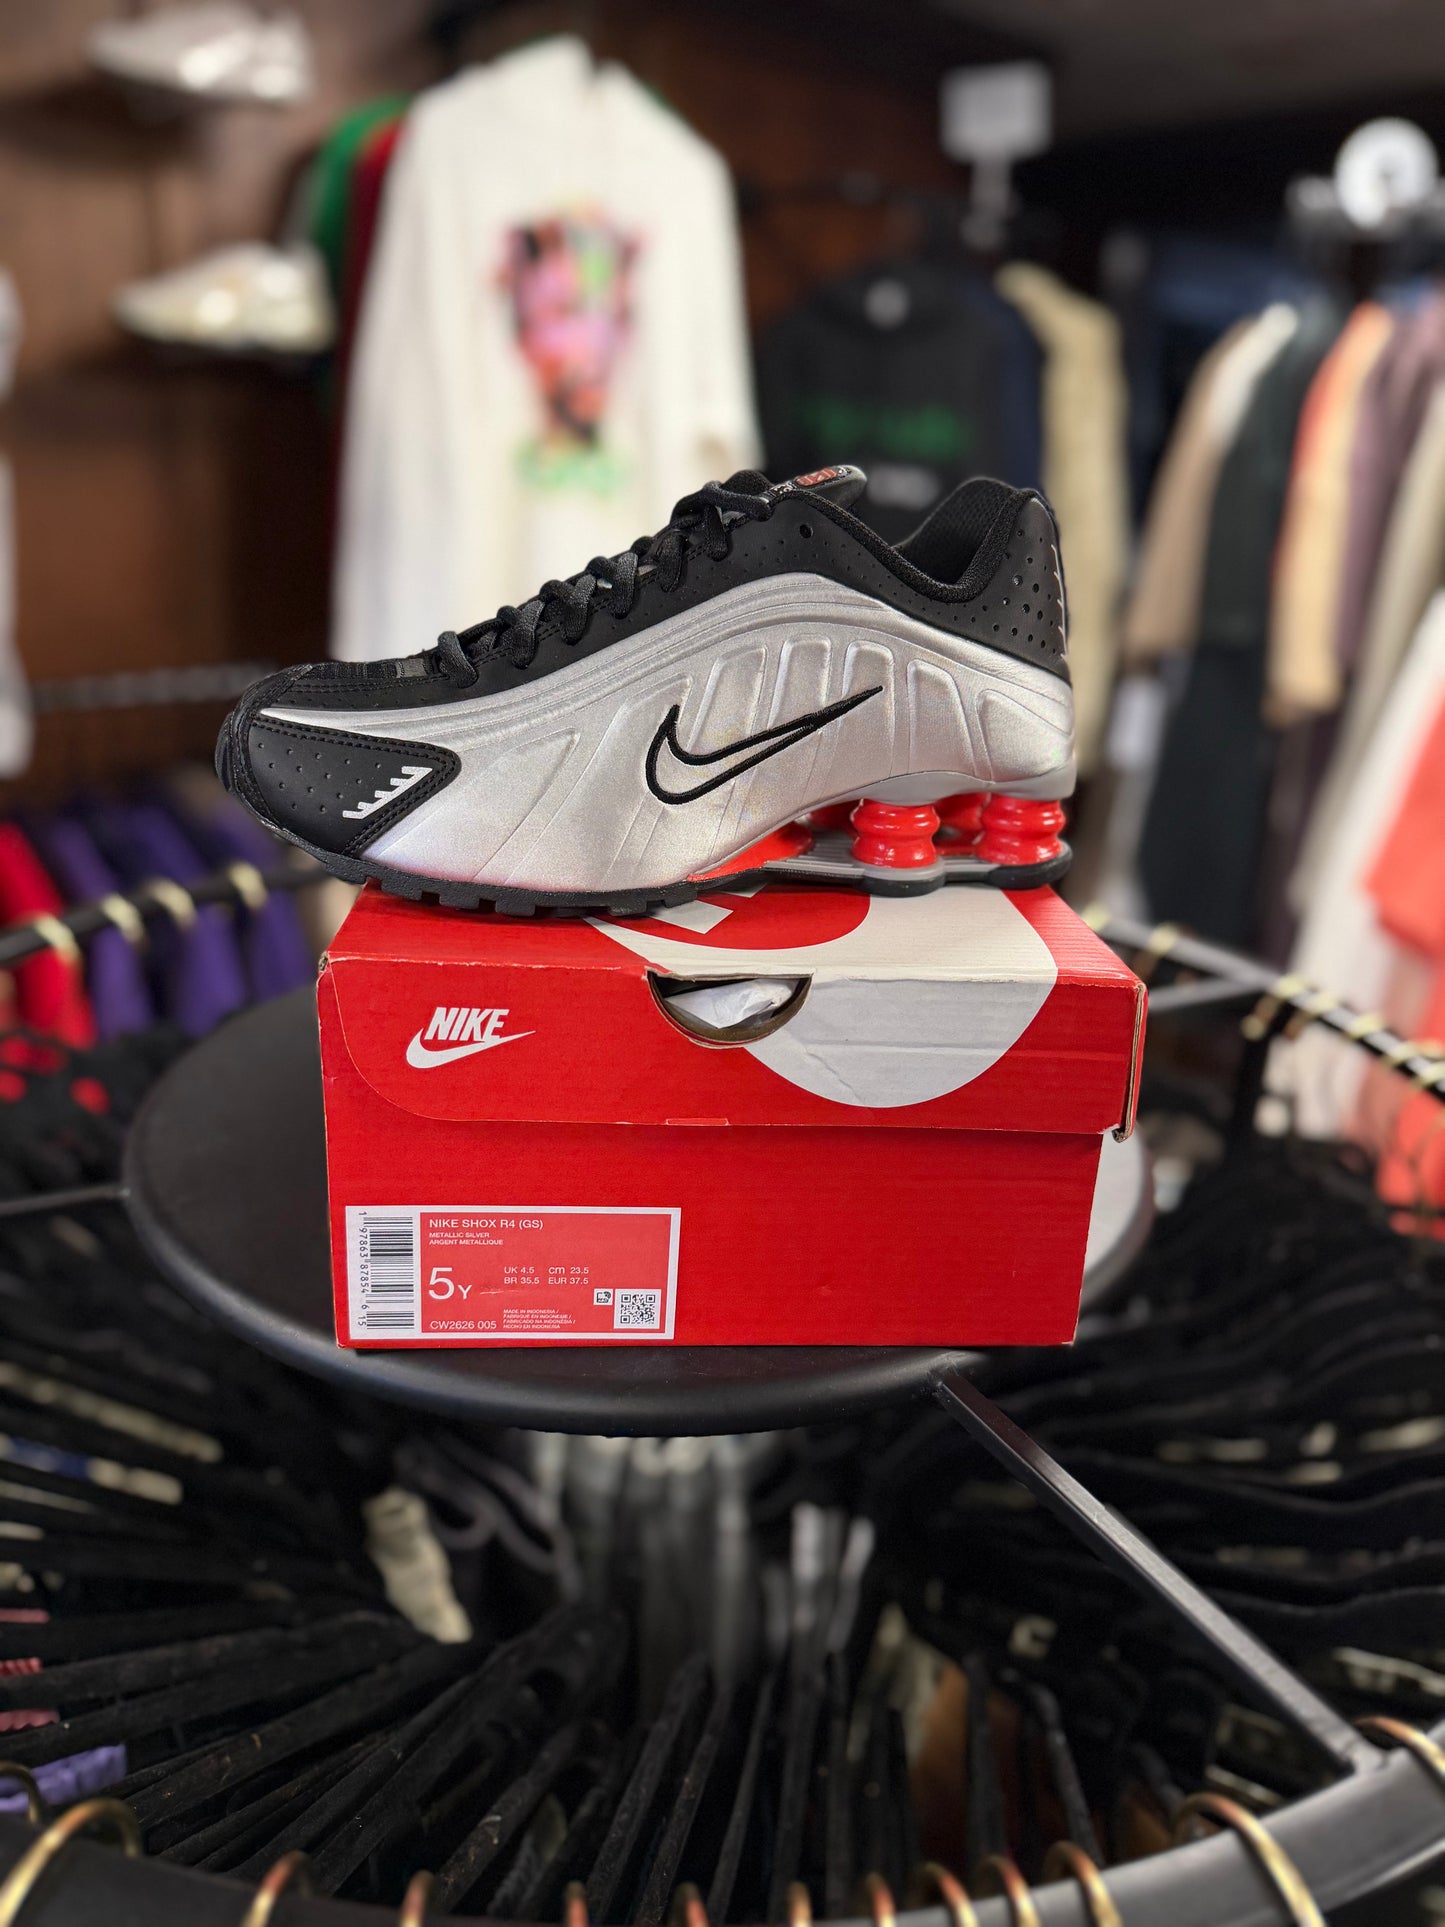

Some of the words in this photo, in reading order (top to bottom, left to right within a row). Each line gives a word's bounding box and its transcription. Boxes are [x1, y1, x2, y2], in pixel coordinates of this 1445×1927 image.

[424, 1007, 510, 1042] NIKE
[429, 1219, 459, 1228] NIKE
[462, 1219, 497, 1228] SHOX
[500, 1219, 515, 1228] R4
[519, 1219, 543, 1230] (GS)
[359, 1227, 368, 1258] 97863
[503, 1266, 518, 1274] UK
[520, 1266, 535, 1274] 4.5
[548, 1267, 566, 1275] cm
[570, 1266, 589, 1274] 23.5
[360, 1264, 369, 1293] 87854
[503, 1277, 518, 1285] BR
[520, 1277, 540, 1285] 35.5
[548, 1277, 567, 1285] EUR
[569, 1277, 589, 1285] 37.5
[430, 1321, 475, 1330] CW2626
[477, 1321, 497, 1330] 005
